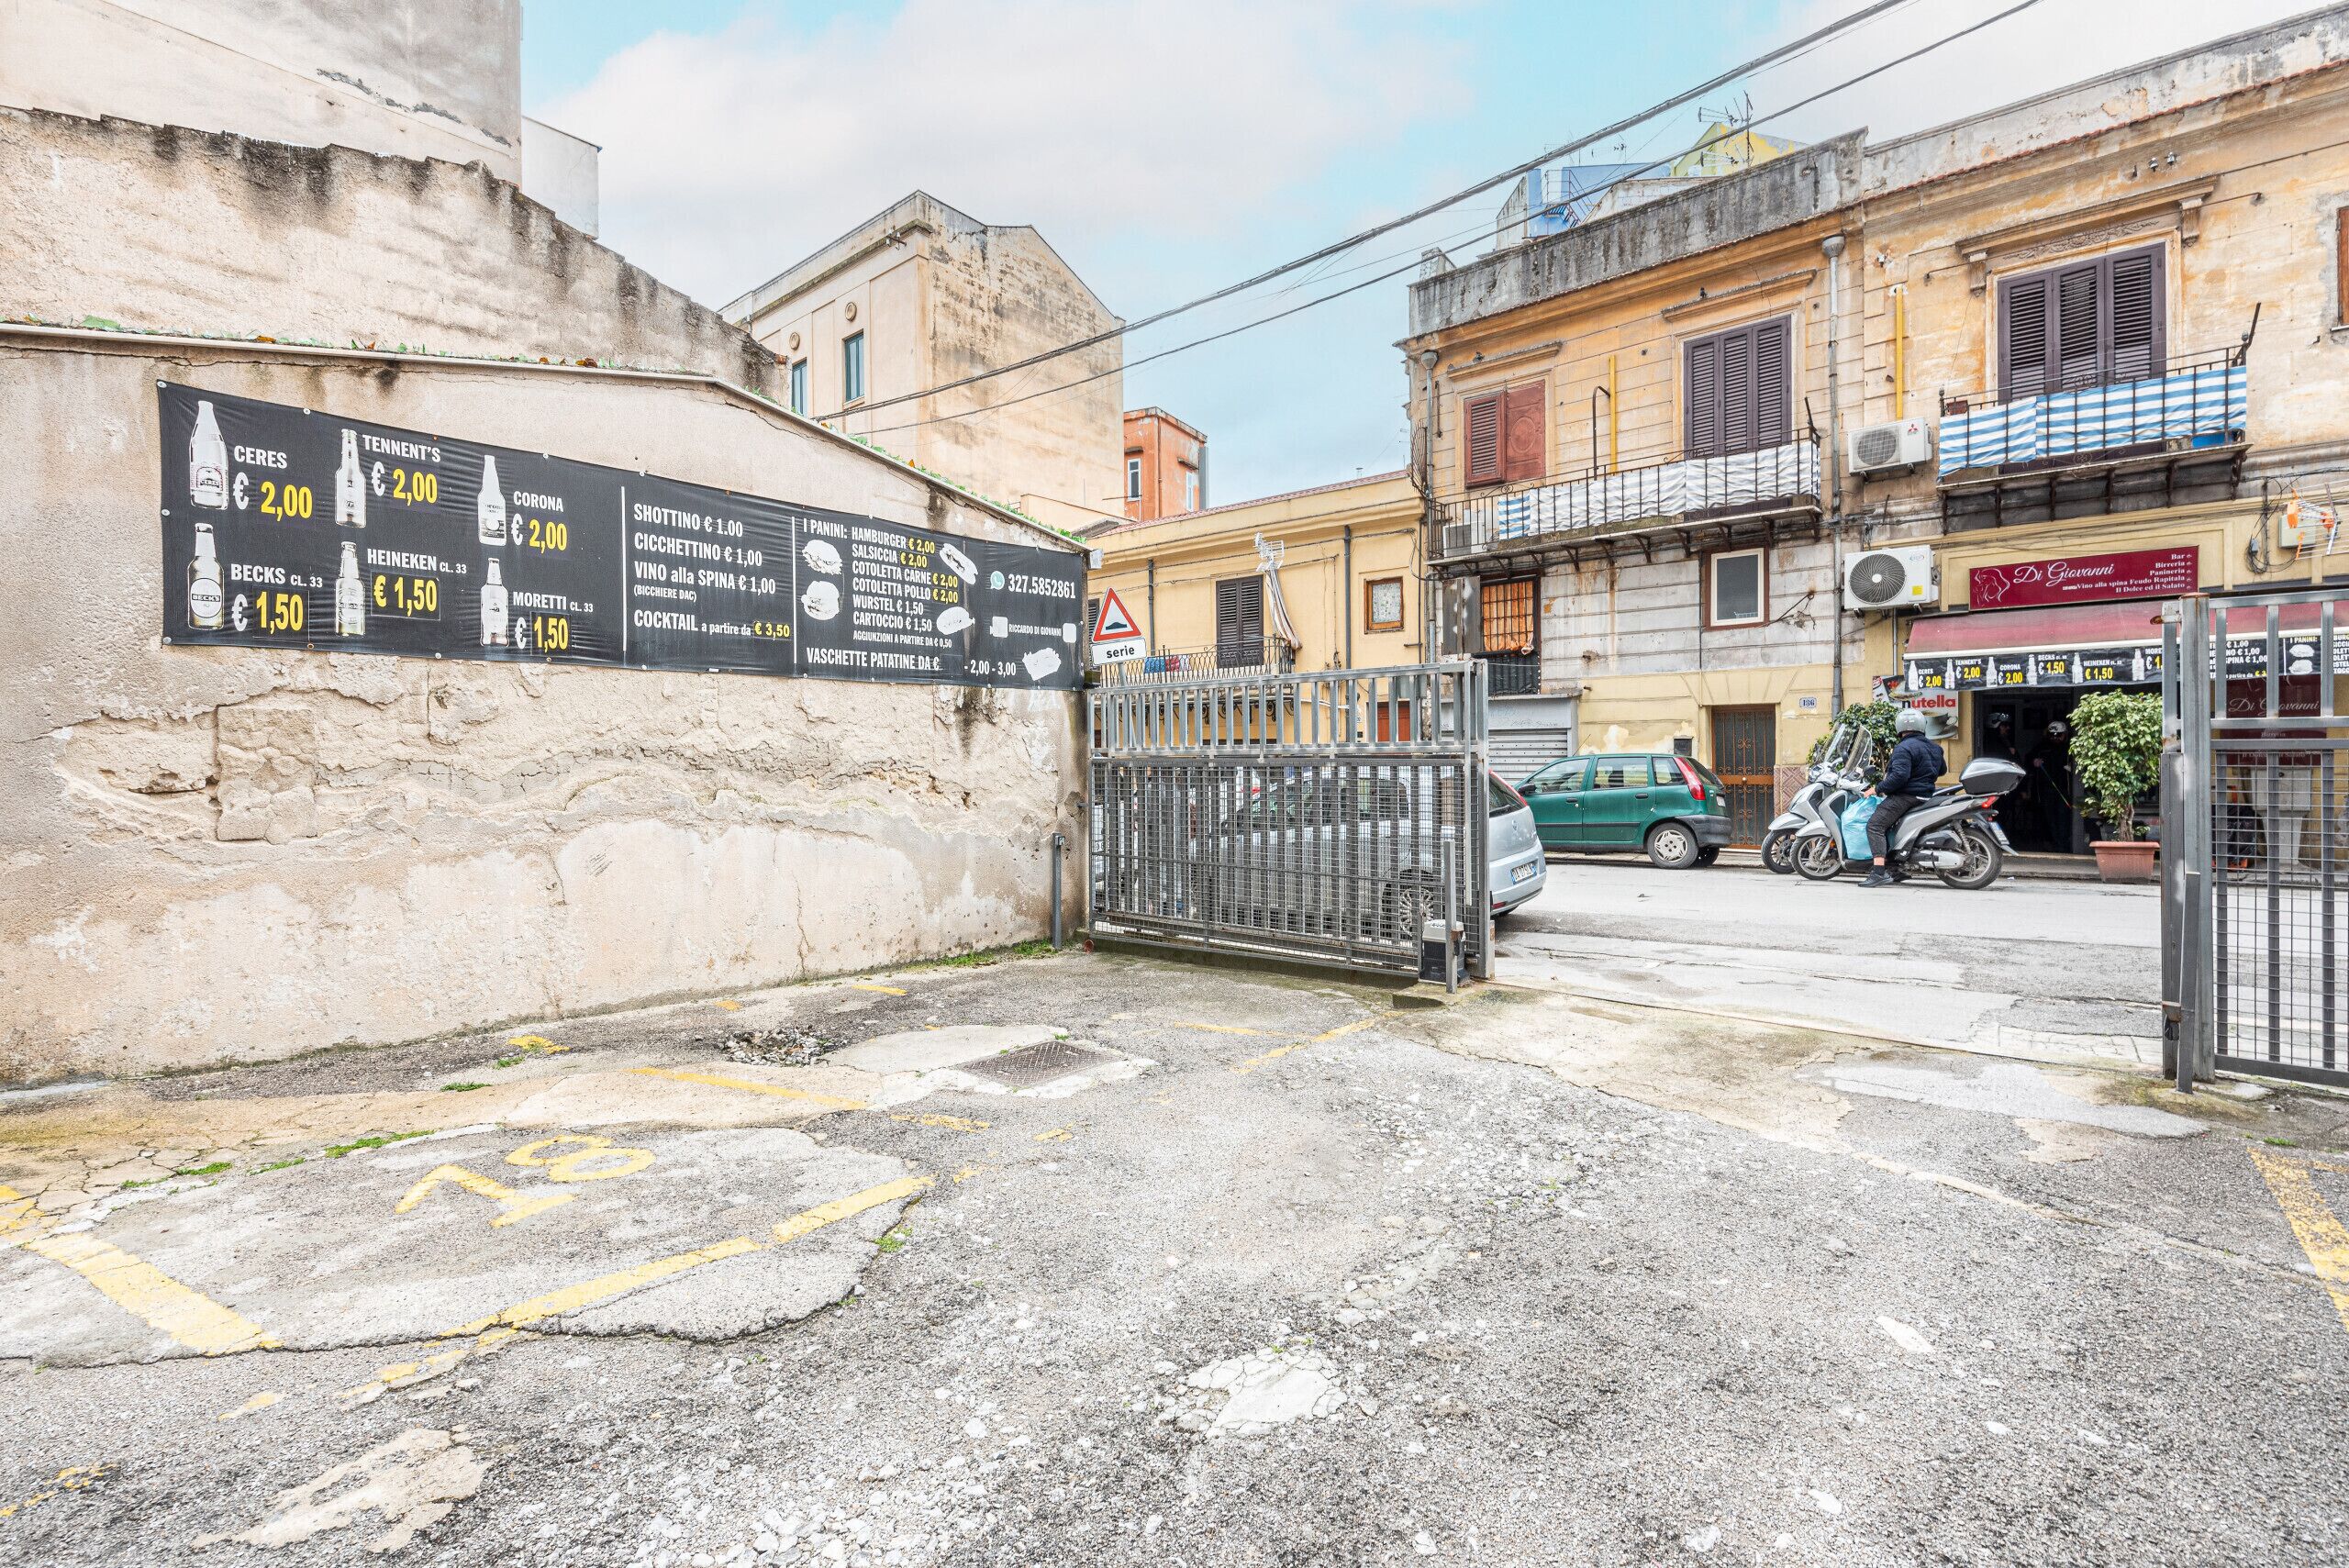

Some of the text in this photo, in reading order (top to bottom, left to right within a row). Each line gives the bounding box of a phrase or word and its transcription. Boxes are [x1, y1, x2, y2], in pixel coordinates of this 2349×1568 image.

[234, 445, 288, 469] CERES
[362, 434, 440, 462] TENNENT'S
[371, 462, 385, 496] €
[393, 468, 438, 506] 2,00
[232, 472, 250, 510] €
[261, 481, 313, 522] 2,00
[514, 490, 564, 513] CORONA
[634, 503, 743, 538] SHOTTINO € 1.00
[803, 517, 848, 539] I PANINI:
[511, 513, 568, 554] € 2,00
[852, 527, 935, 555] HAMBURGER € 2,00
[367, 548, 467, 573] HEINEKEN CL. 33
[634, 532, 763, 568] CICCHETTINO € 1,00
[852, 543, 928, 570] SALSICCIA € 2,00
[230, 563, 323, 588] BECKS CL. 33
[634, 561, 776, 596] VINO alla SPINA € 1,00
[852, 560, 959, 589] COTOLETTA CARNE € 2,00
[1008, 573, 1076, 599] 327.5852861
[2013, 562, 2115, 587] Di Giovanni
[373, 574, 438, 617] € 1,50
[513, 591, 594, 613] MORETTI CL. 33
[633, 584, 697, 603] (BICCHIERE DAC)
[852, 577, 959, 605] COTOLETTA POLLO € 2,00
[231, 591, 304, 635] € 1,50
[852, 594, 924, 617] WURSTEL € 1,50
[515, 616, 568, 652] € 1,50
[633, 609, 791, 640] COCKTAIL a partire da € 3,50
[852, 611, 932, 634] CARTOCCIO € 1,50
[1008, 623, 1063, 637] RICCARDO DI GIOVANNI
[852, 629, 952, 650] AGGIUNZIONI A PARTIRE DA € 0,50
[1106, 645, 1135, 659] serie
[807, 647, 868, 665] VASCHETTE
[871, 651, 916, 670] PATATINE
[918, 656, 931, 671] DA
[933, 656, 940, 672] €
[970, 660, 990, 677] 2,00
[997, 662, 1017, 677] 3,00
[2083, 659, 2110, 667] HEINEKEN
[2243, 648, 2260, 657] 1,00
[1955, 666, 1981, 680] € 2,00
[1998, 672, 2023, 684] € 2,00
[2038, 661, 2065, 675] € 1,50
[2085, 667, 2113, 682] € 1,50
[1918, 675, 1943, 688] € 2,00
[1901, 695, 1956, 709] nutella
